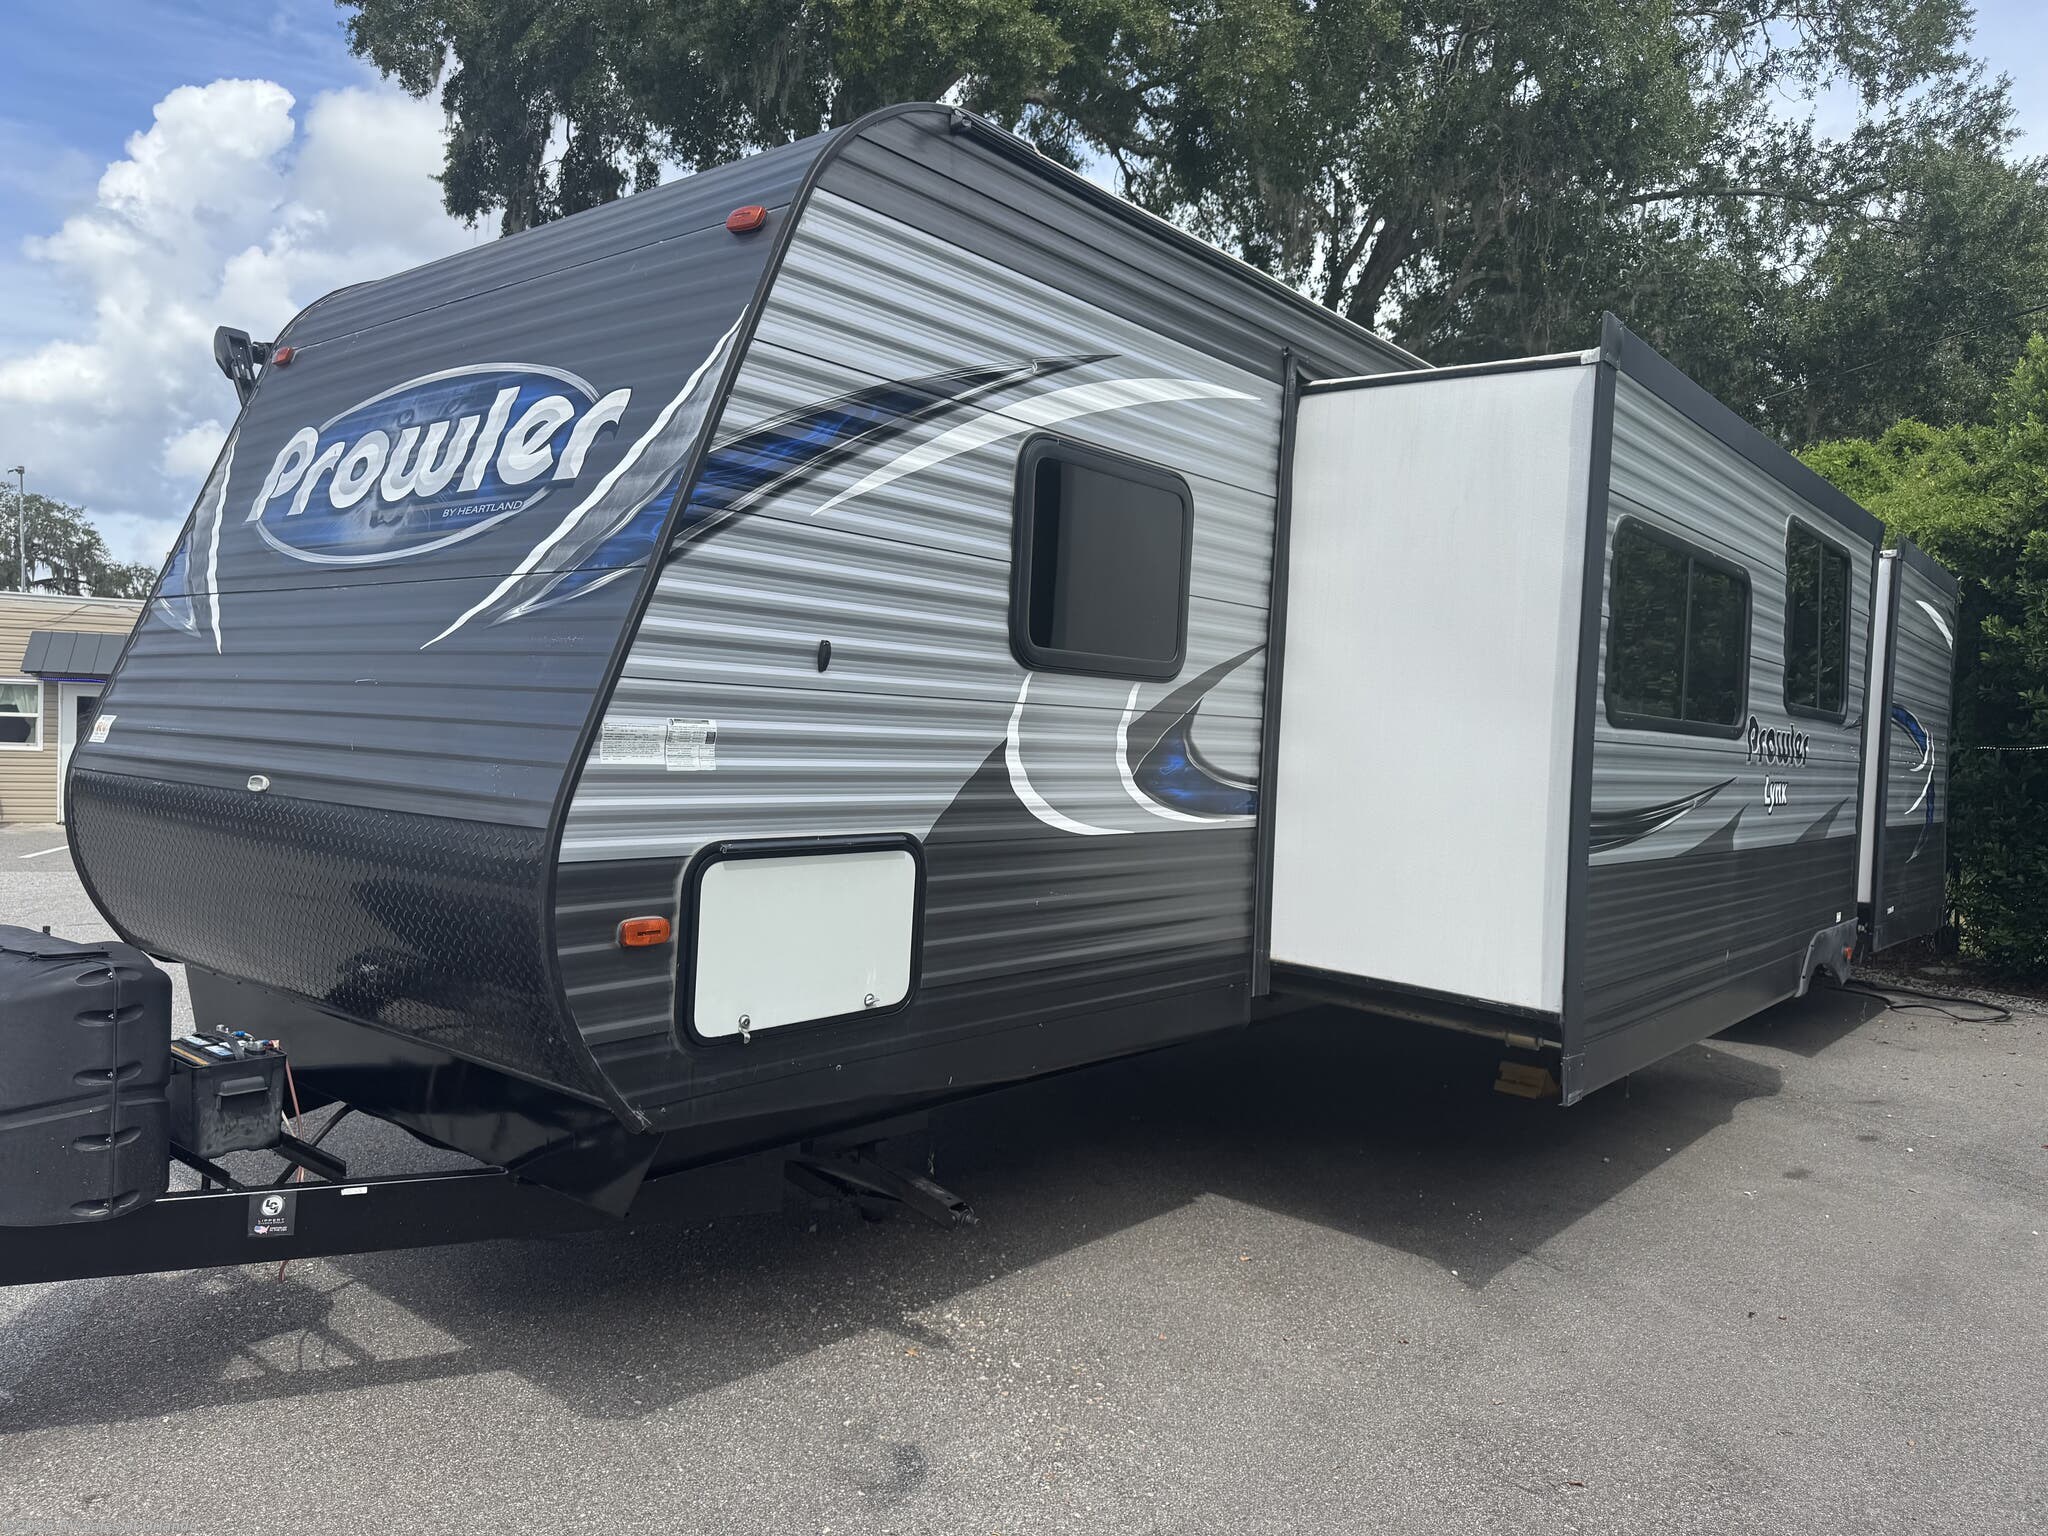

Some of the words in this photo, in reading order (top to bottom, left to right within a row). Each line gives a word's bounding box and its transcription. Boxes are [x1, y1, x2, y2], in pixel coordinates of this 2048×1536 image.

[245, 386, 632, 523] Prowler
[442, 508, 457, 518] BY
[457, 500, 523, 516] HEARTLAND
[1746, 714, 1810, 768] Prowler
[1764, 774, 1788, 814] Lynx
